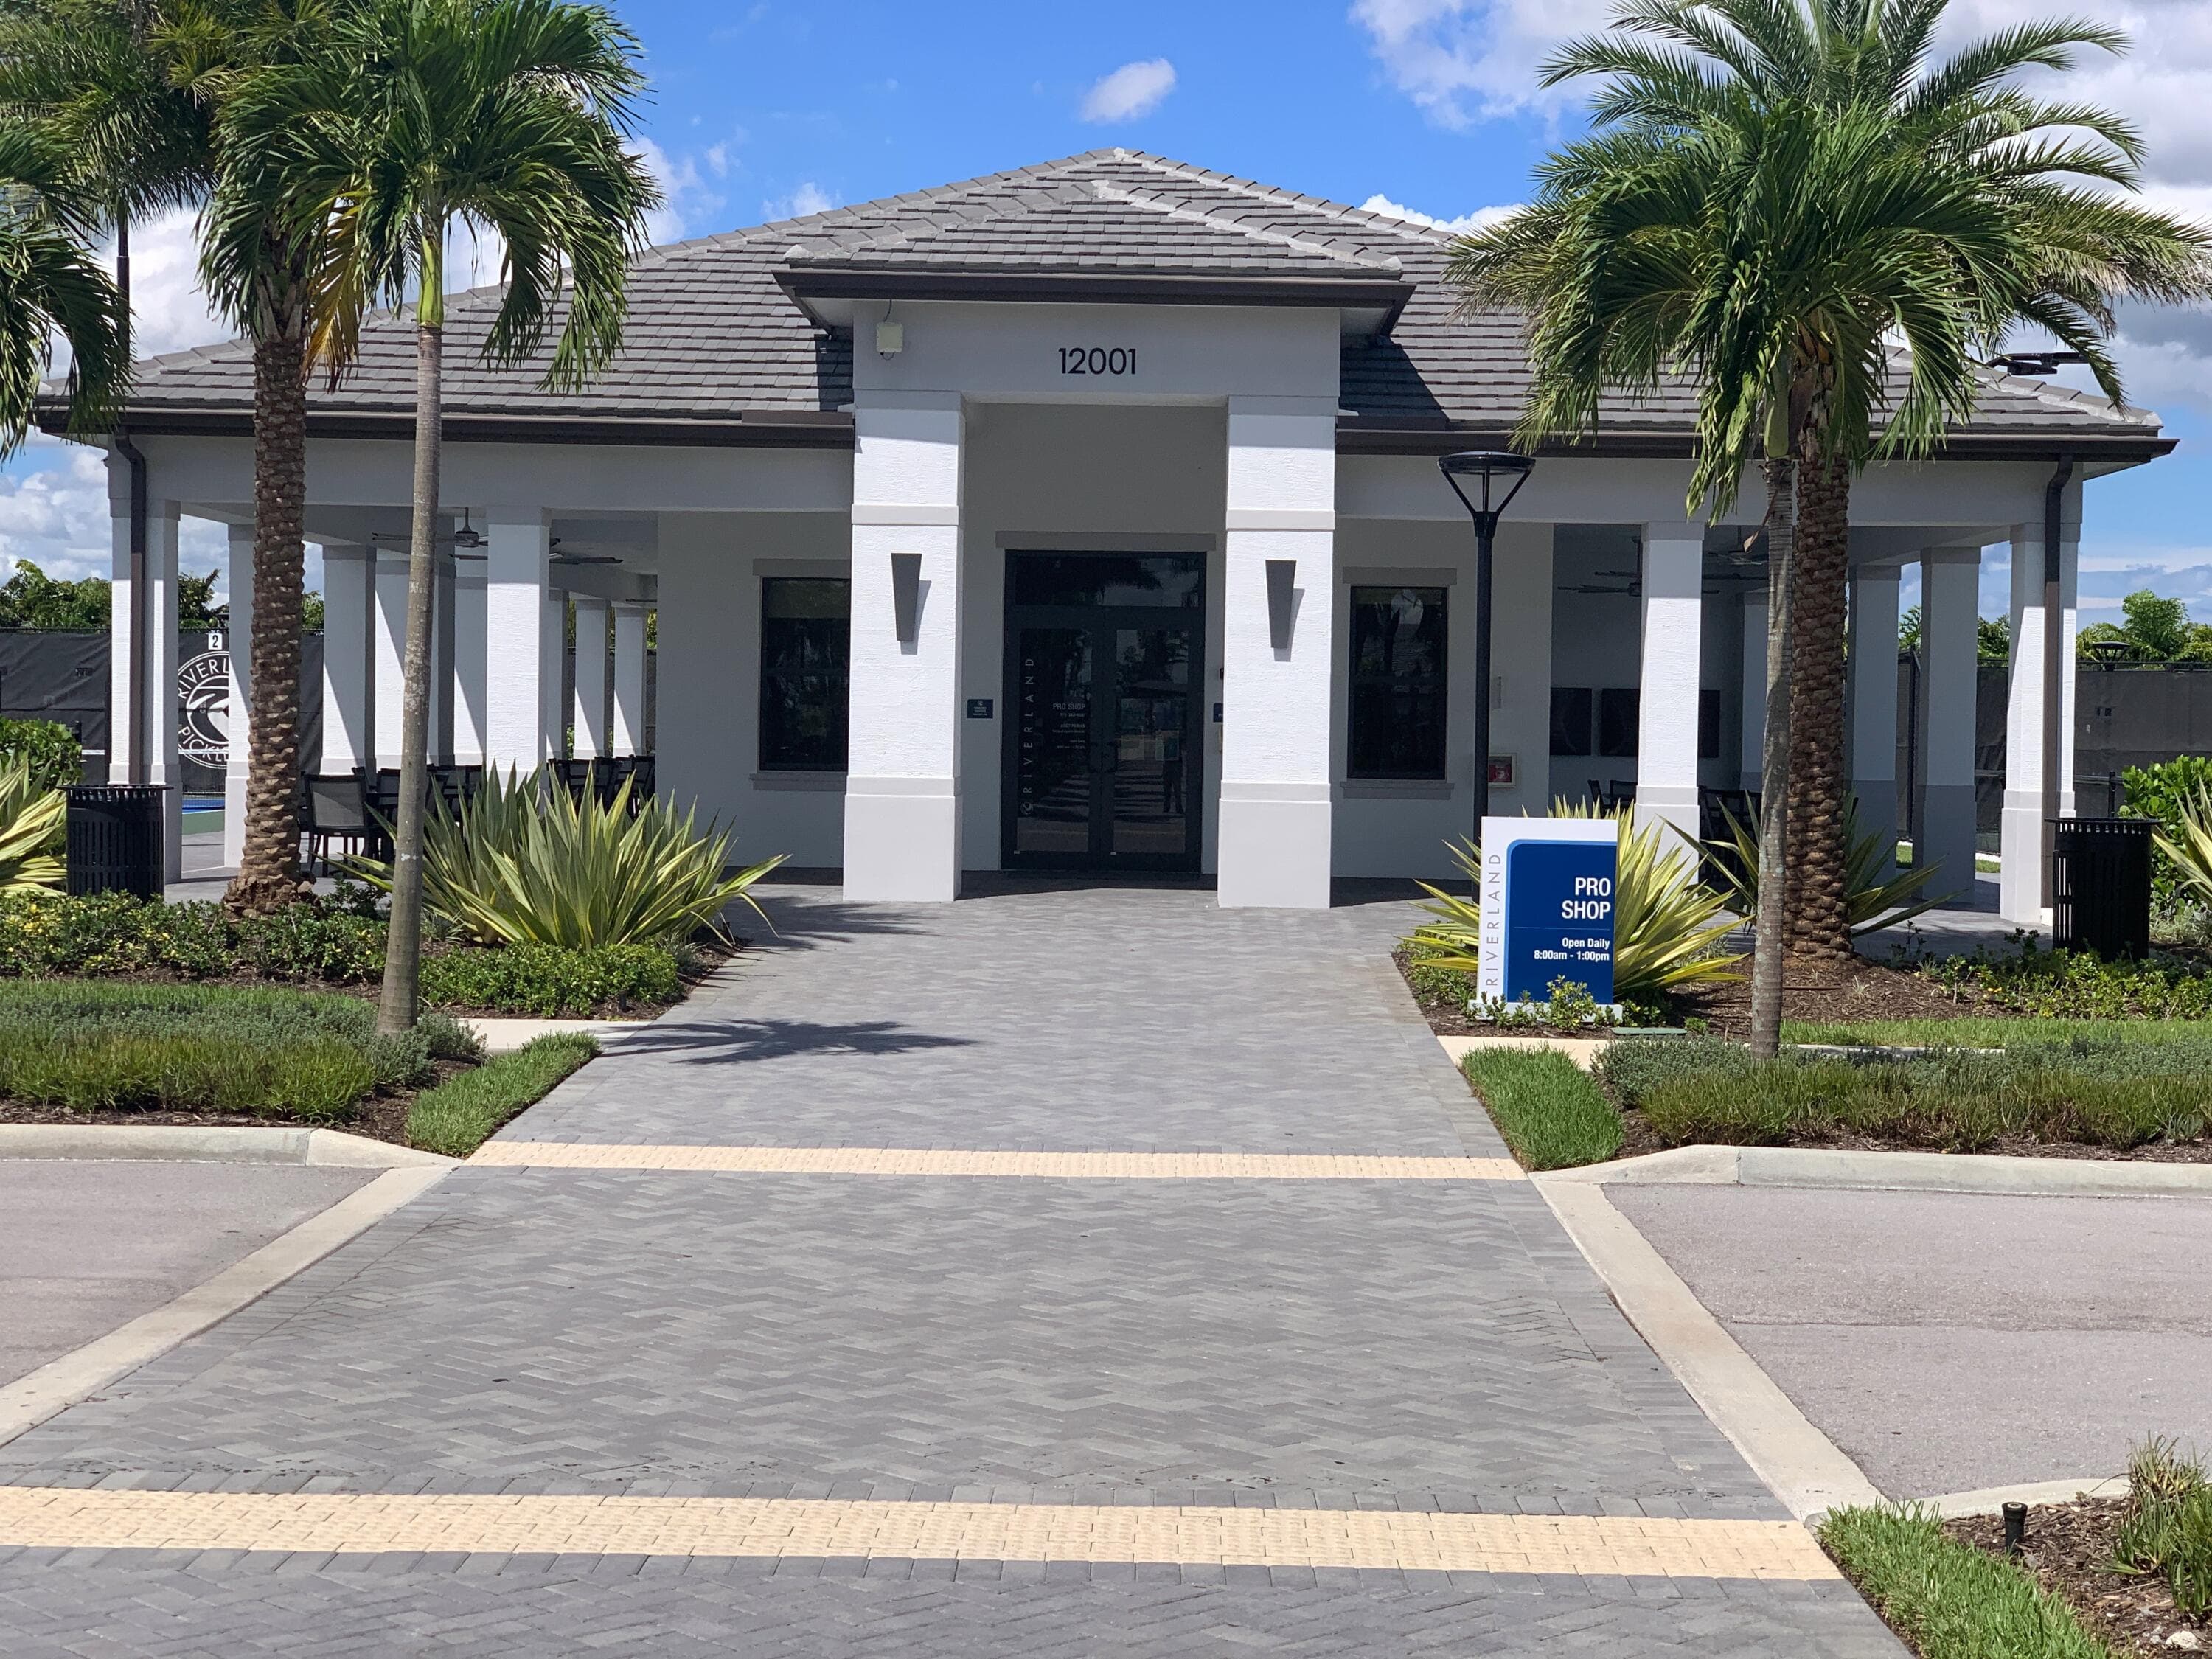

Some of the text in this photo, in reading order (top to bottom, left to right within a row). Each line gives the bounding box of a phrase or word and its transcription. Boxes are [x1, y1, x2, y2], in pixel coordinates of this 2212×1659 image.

[1058, 347, 1136, 375] 12001
[212, 634, 219, 648] 2
[178, 658, 229, 699] RIVERL
[1068, 703, 1086, 711] SHOP
[1023, 658, 1034, 793] RIVERLAND
[1574, 877, 1611, 897] PRO
[1562, 900, 1611, 920] SHOP
[1485, 855, 1501, 987] RIVERLAND
[1562, 937, 1610, 950] Open Daily
[1534, 950, 1568, 960] 8:00am
[1576, 950, 1610, 962] 1:00pm
